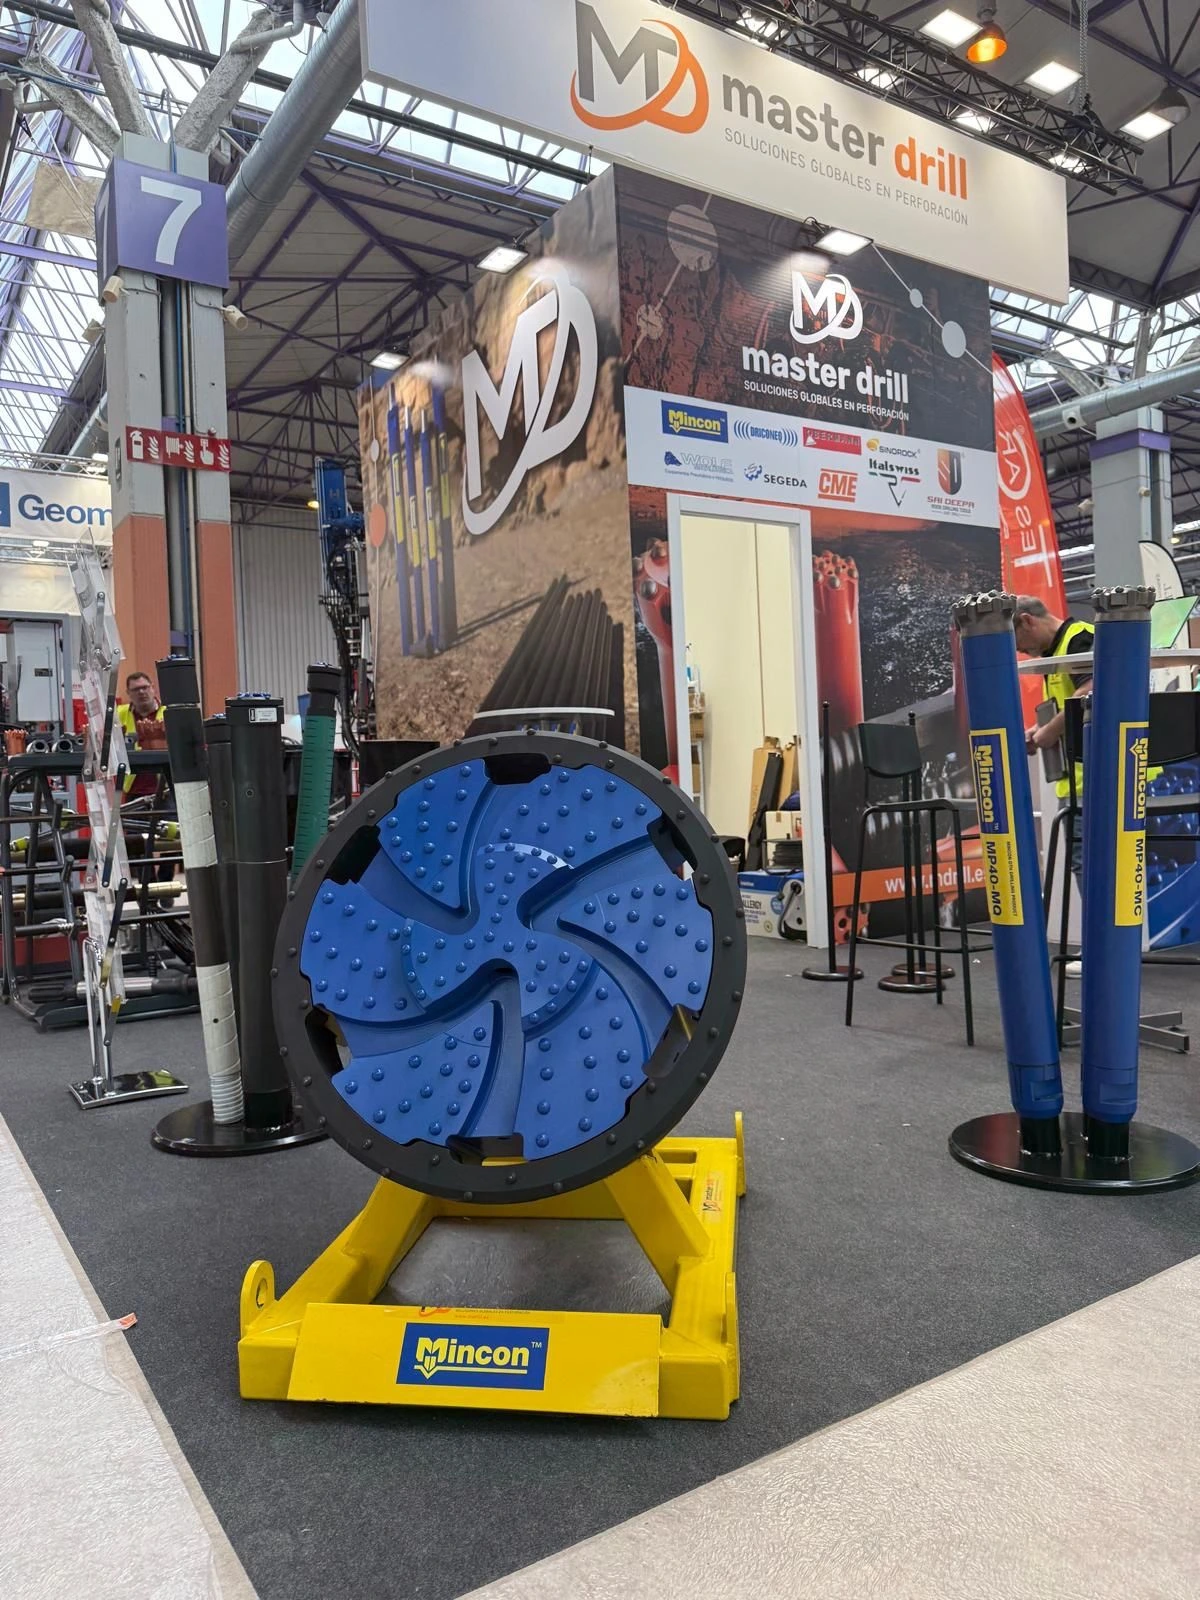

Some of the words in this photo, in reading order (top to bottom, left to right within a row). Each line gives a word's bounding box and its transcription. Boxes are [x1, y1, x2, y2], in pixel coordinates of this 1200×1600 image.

[722, 74, 885, 166] master
[894, 136, 968, 200] drill
[724, 127, 806, 168] SOLUCIONES
[810, 158, 872, 192] GLOBALES
[876, 183, 891, 198] EN
[895, 188, 968, 226] PERFORACIÓN
[140, 175, 202, 266] 7
[742, 346, 851, 390] master
[855, 365, 909, 404] drill
[743, 380, 799, 400] SOLUCIONES
[800, 391, 843, 409] GLOBALES
[844, 400, 855, 411] EN
[856, 402, 910, 421] PERFORACIÓN
[668, 409, 721, 433] Mincon
[763, 474, 808, 488] SEGEDA
[818, 472, 858, 498] CME
[869, 458, 920, 476] Italswiss
[975, 744, 995, 823] Mincon
[985, 841, 1002, 917] MP40-MQ
[1133, 838, 1144, 917] MP40-MC
[415, 1337, 530, 1372] Mincon
